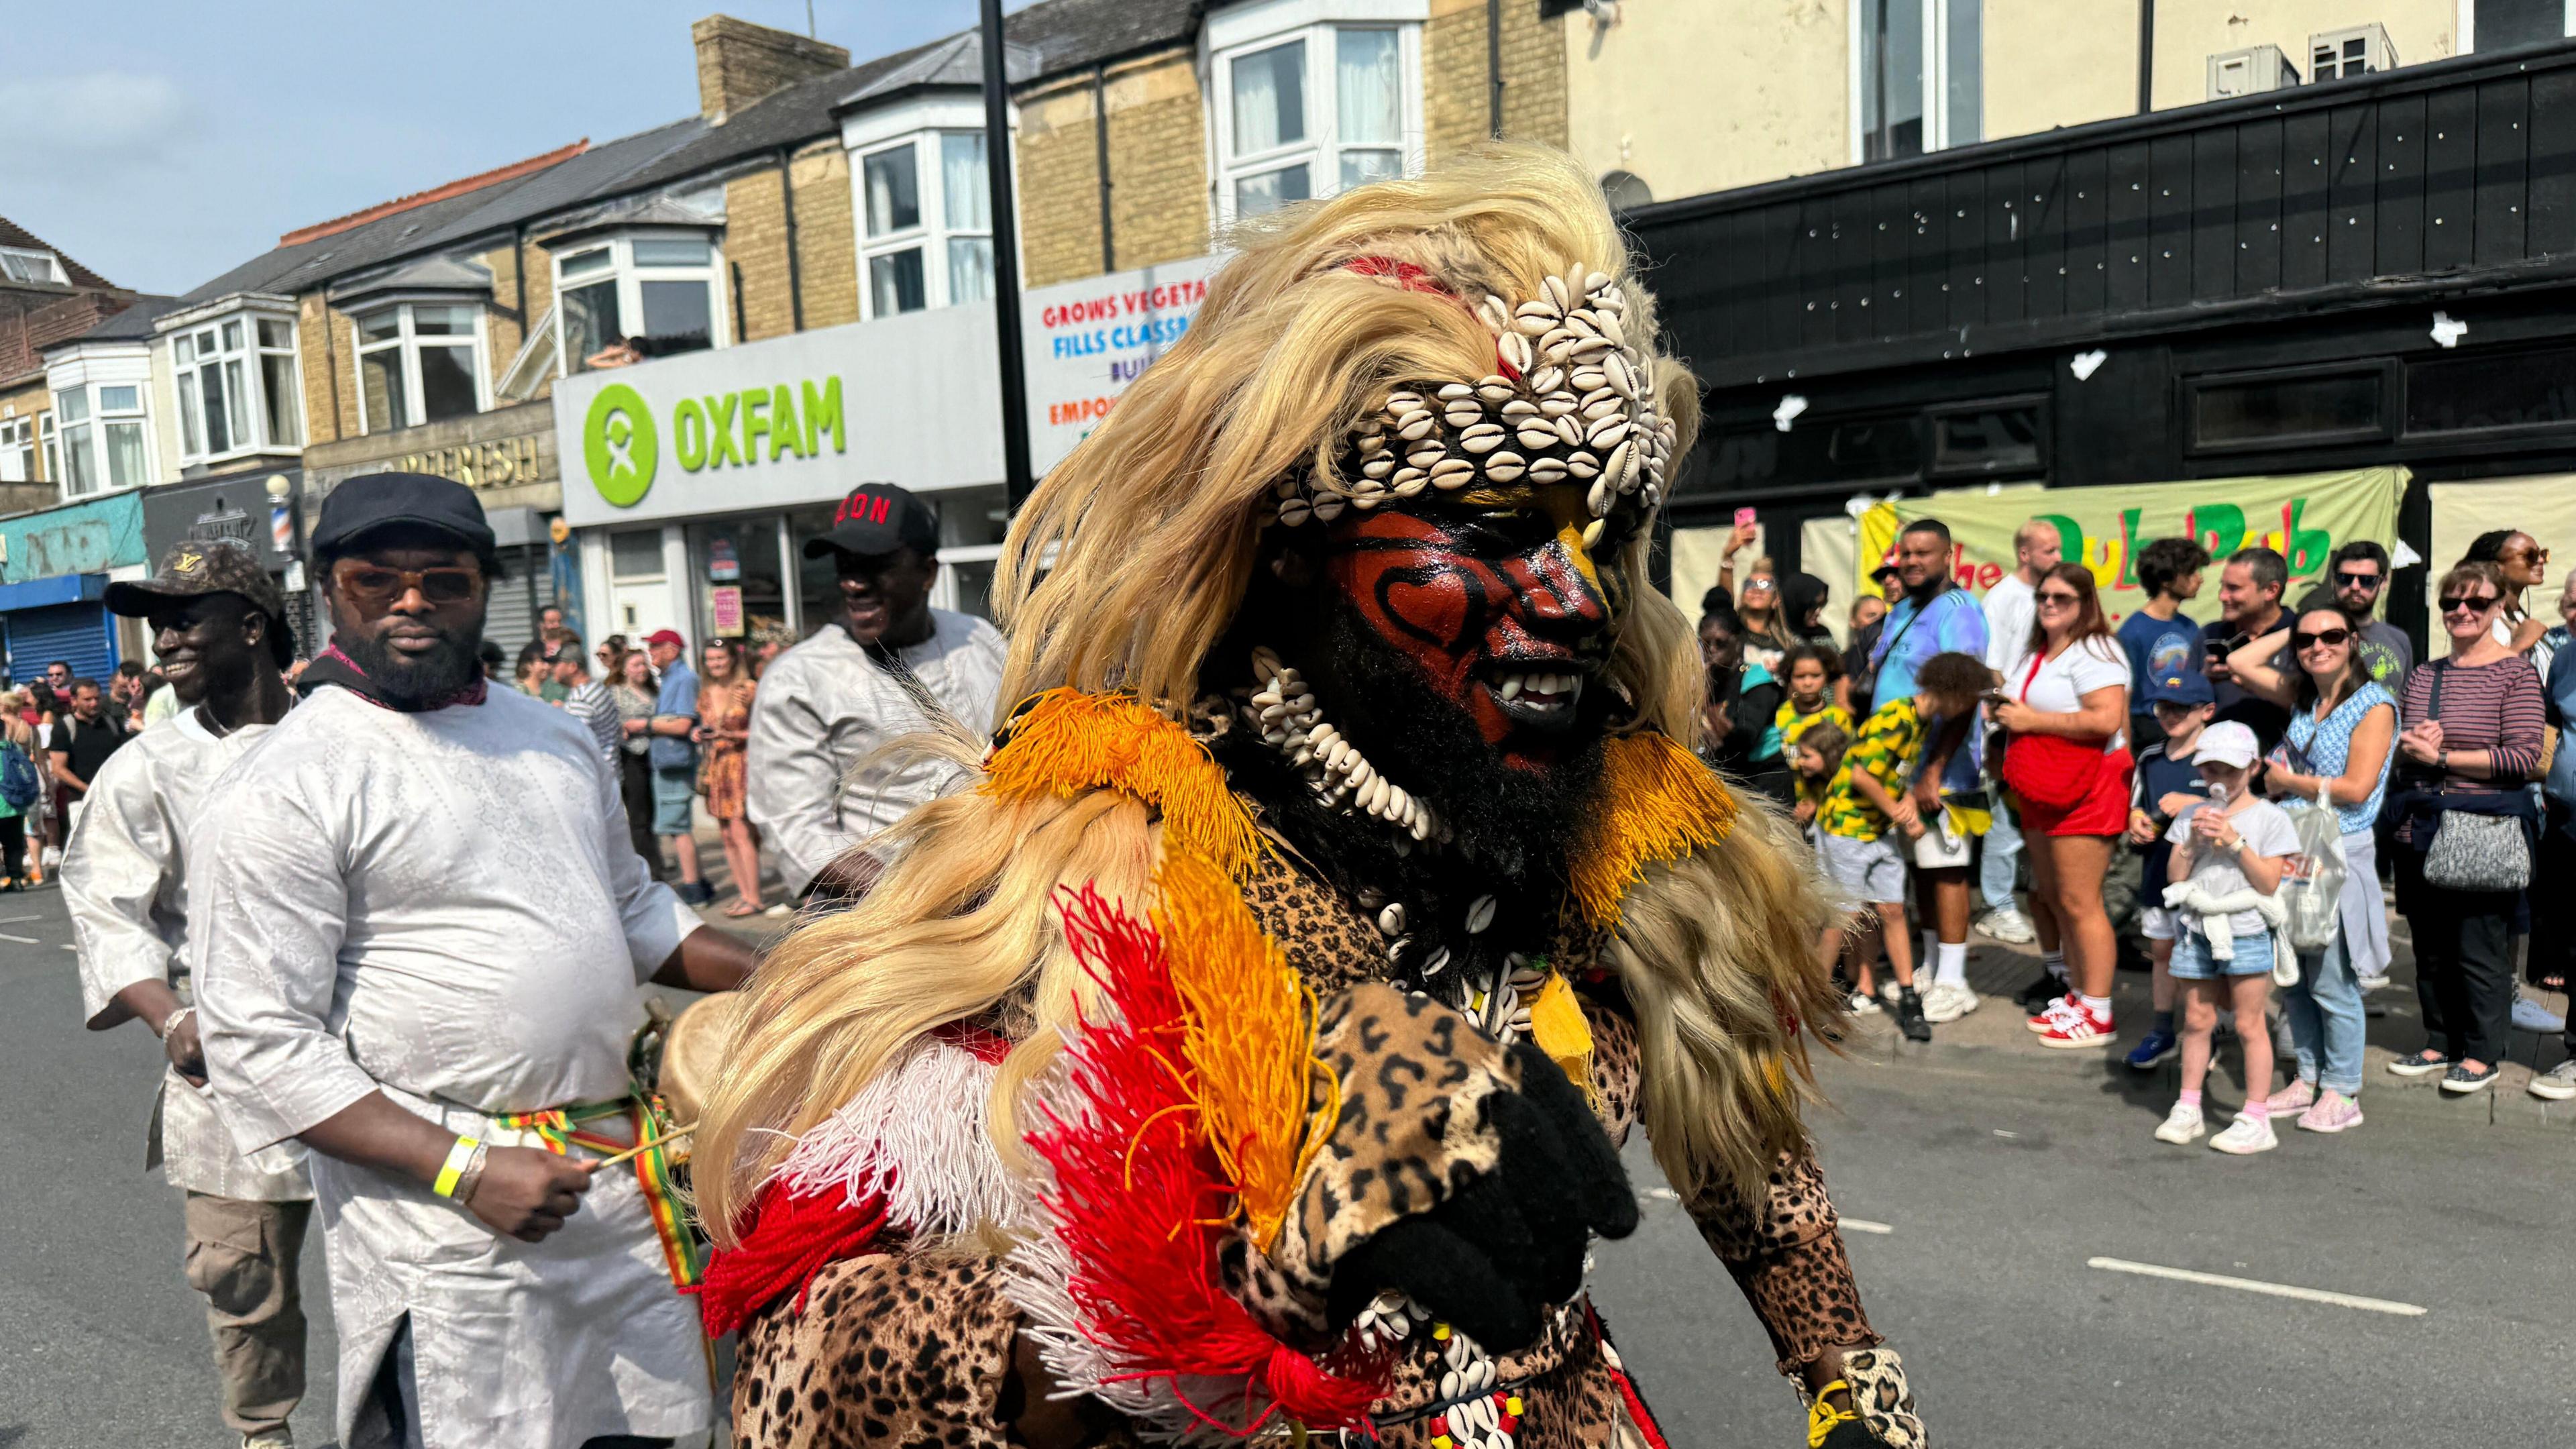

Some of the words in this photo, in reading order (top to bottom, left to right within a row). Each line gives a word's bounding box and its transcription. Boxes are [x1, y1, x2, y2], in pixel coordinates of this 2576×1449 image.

[1042, 295, 1118, 329] GROWS
[1053, 331, 1106, 359] FILLS
[673, 374, 847, 474] OXFAM
[2185, 497, 2330, 584] Pb
